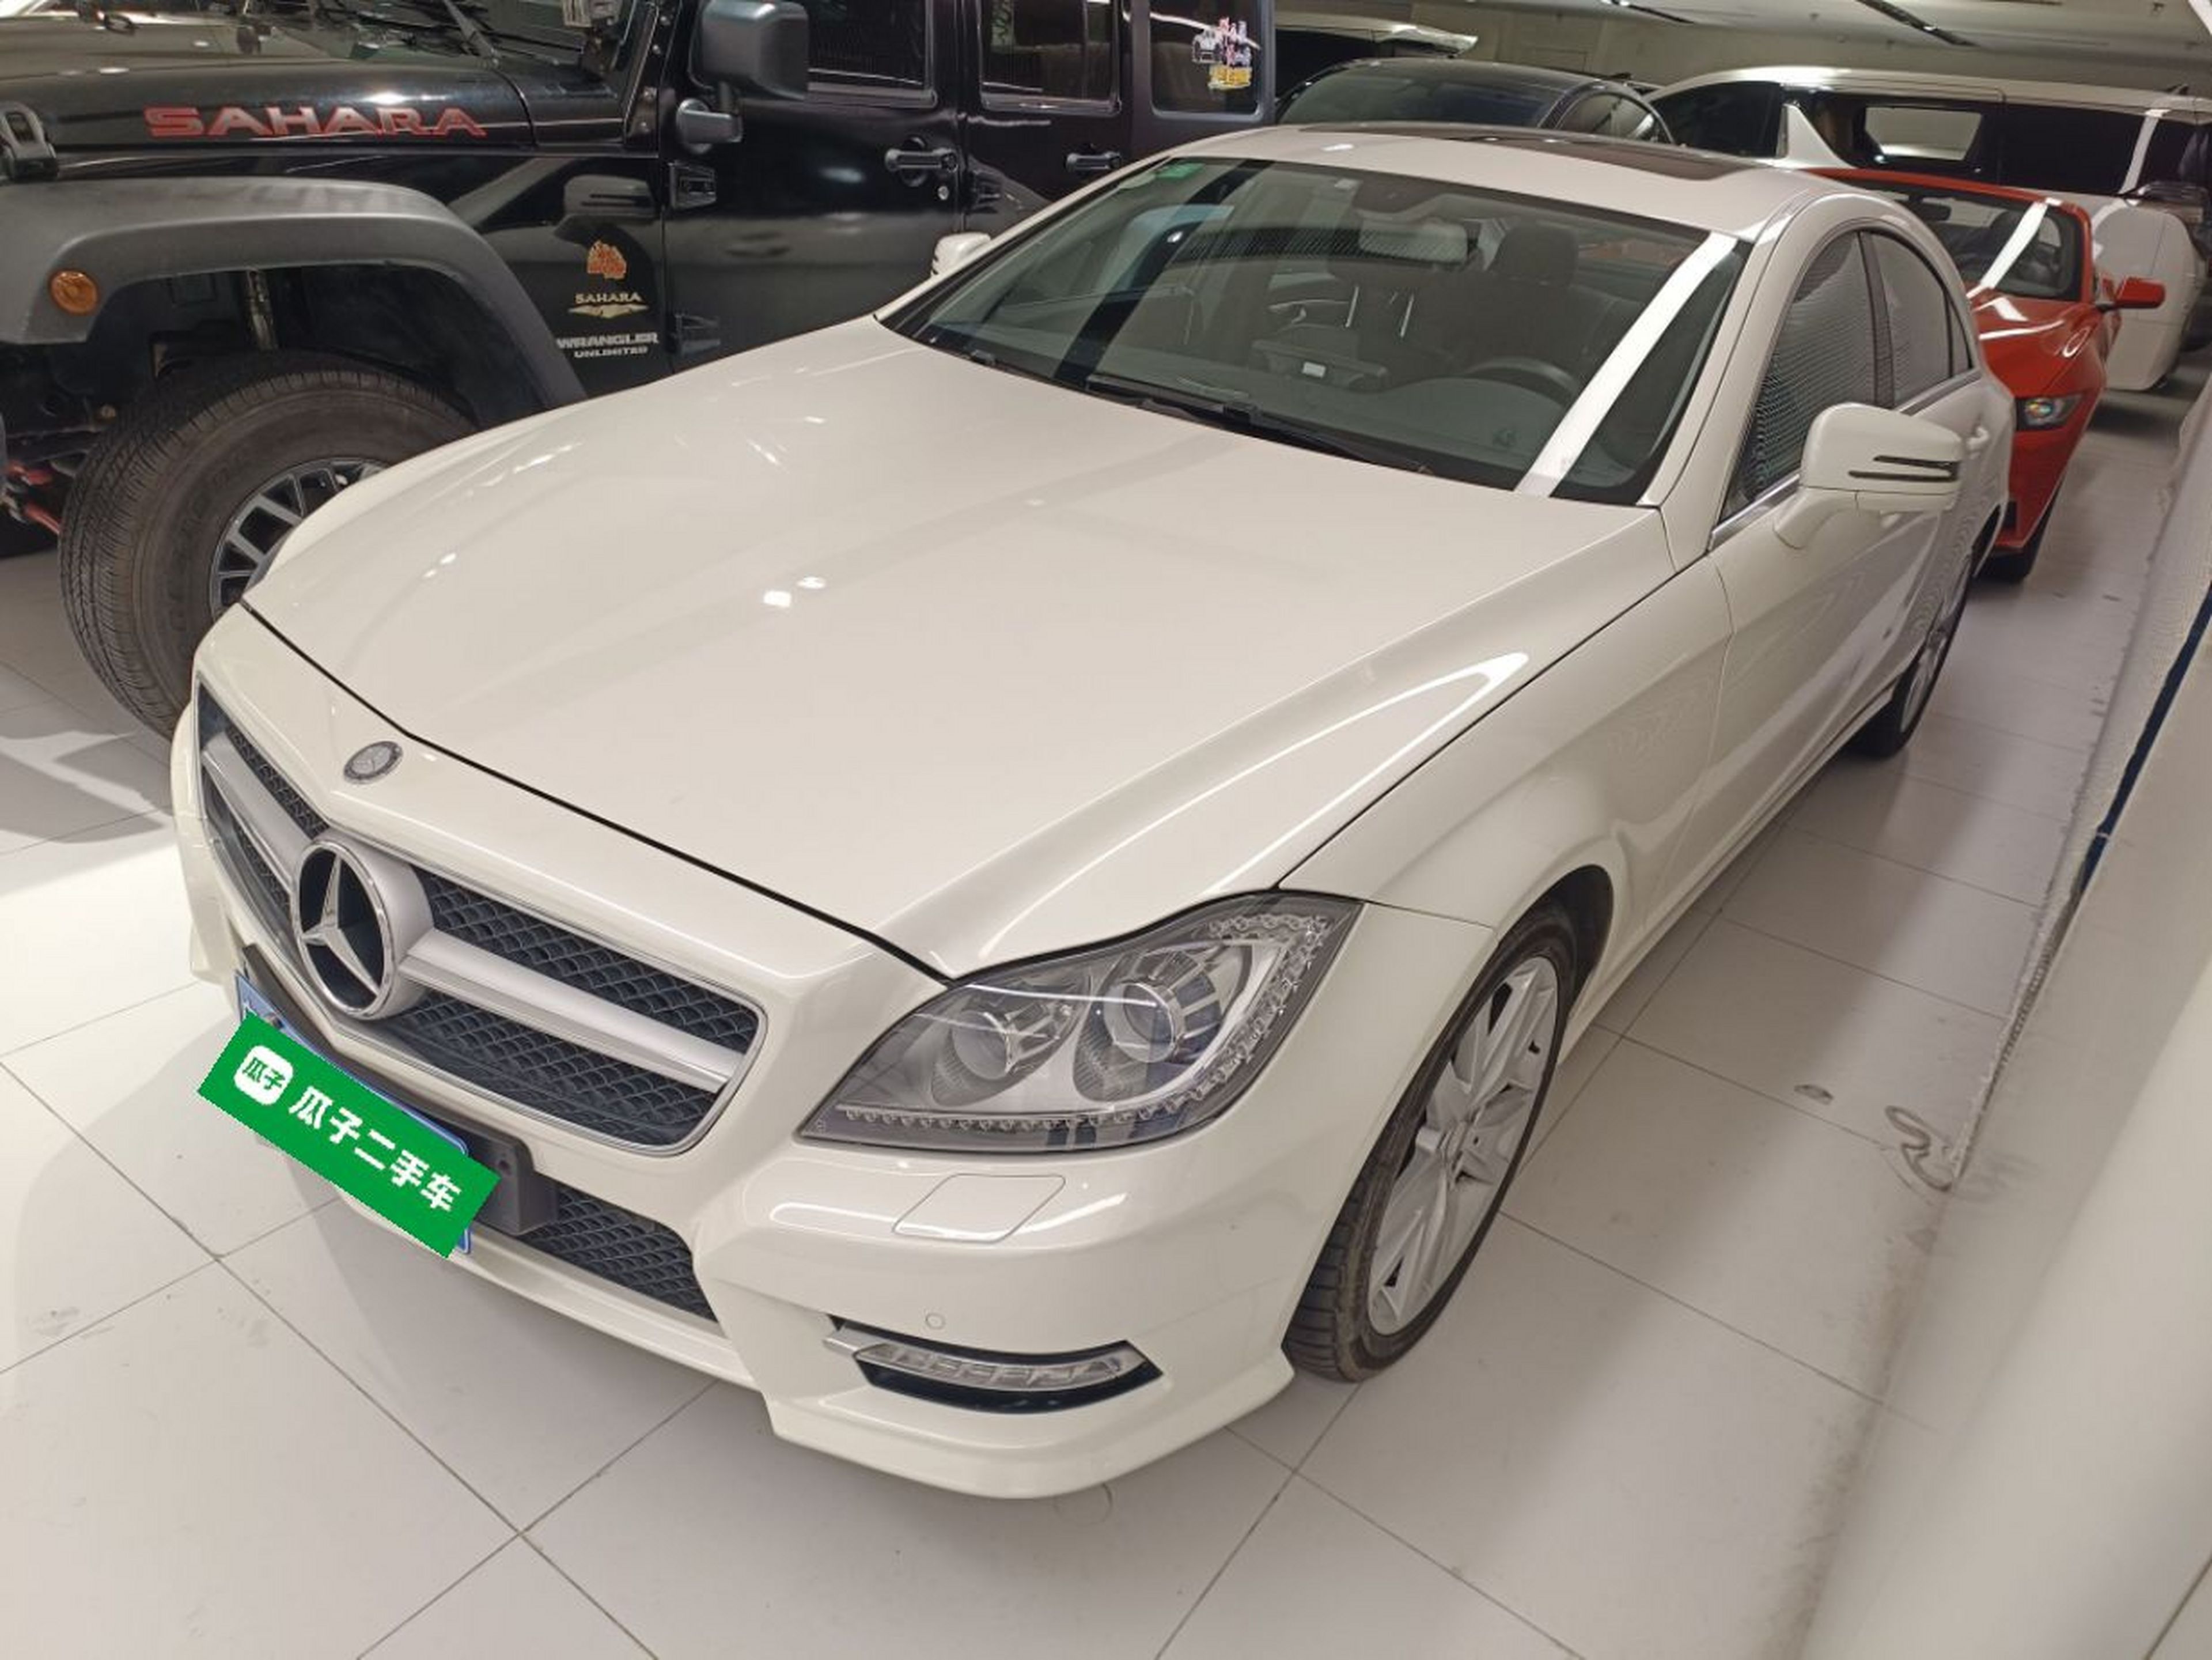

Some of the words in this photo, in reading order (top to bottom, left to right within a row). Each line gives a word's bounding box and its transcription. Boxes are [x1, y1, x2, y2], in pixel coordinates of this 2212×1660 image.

[143, 106, 487, 137] SAHARA
[575, 292, 643, 304] SAHARA
[556, 332, 659, 349] WRANGLER
[574, 346, 649, 358] UNLIMITED
